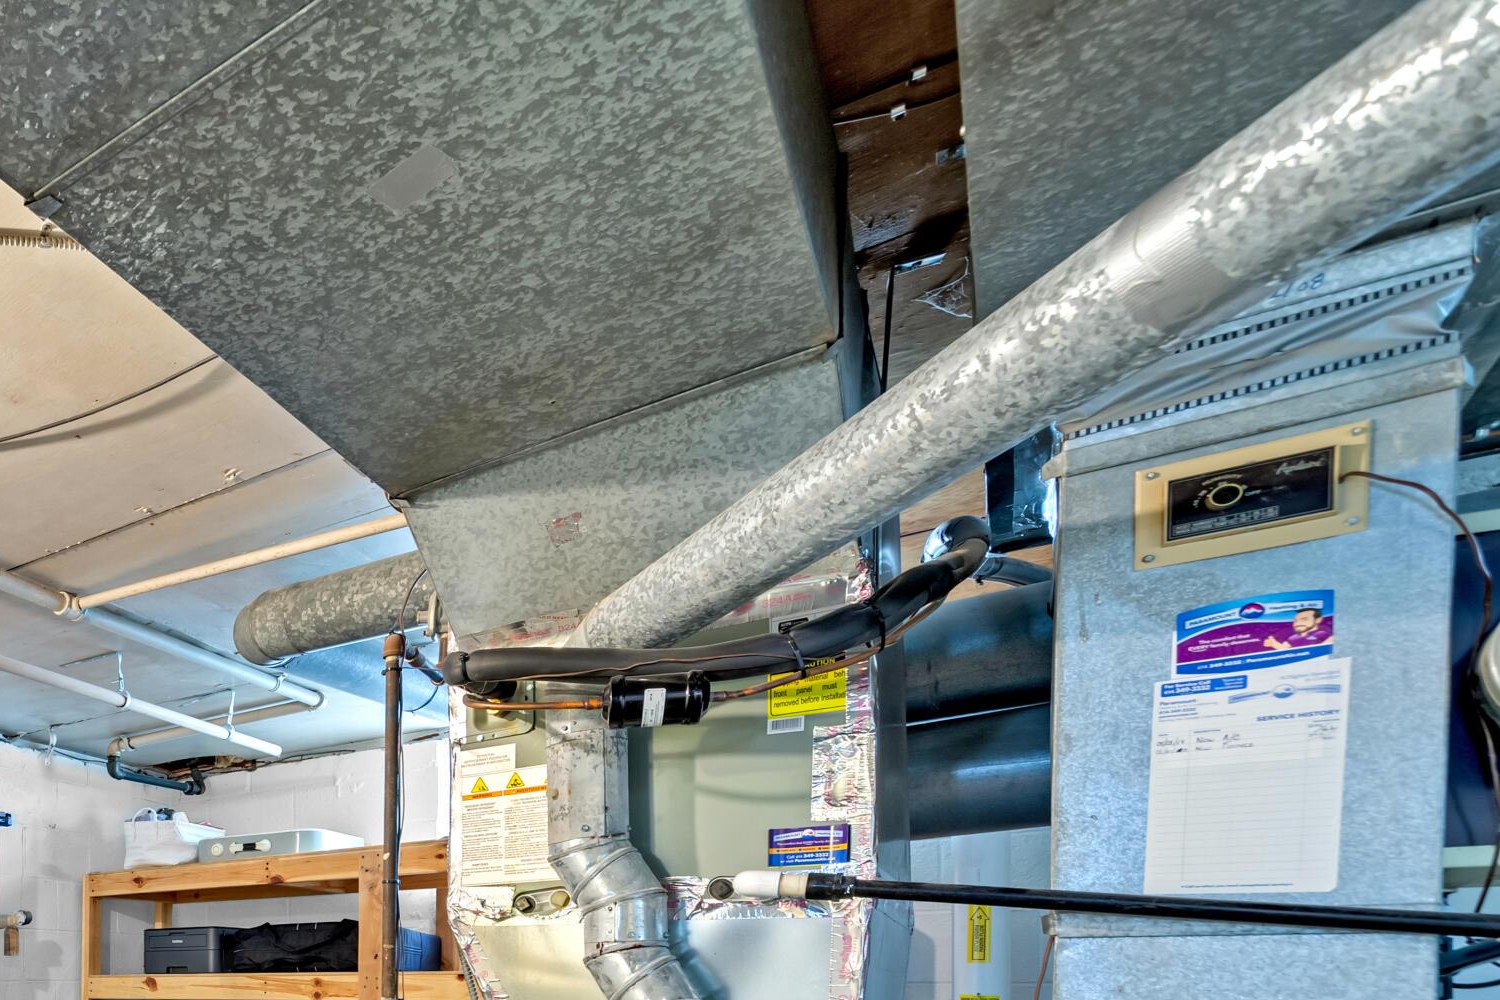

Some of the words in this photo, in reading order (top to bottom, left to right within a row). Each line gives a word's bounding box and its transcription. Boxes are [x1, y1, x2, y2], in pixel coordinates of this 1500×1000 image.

[773, 689, 787, 698] front
[796, 685, 812, 695] panel
[821, 682, 837, 690] must
[773, 698, 799, 708] removed
[800, 696, 819, 704] before
[1256, 713, 1295, 722] SERVICE
[1297, 709, 1341, 718] HISTORY
